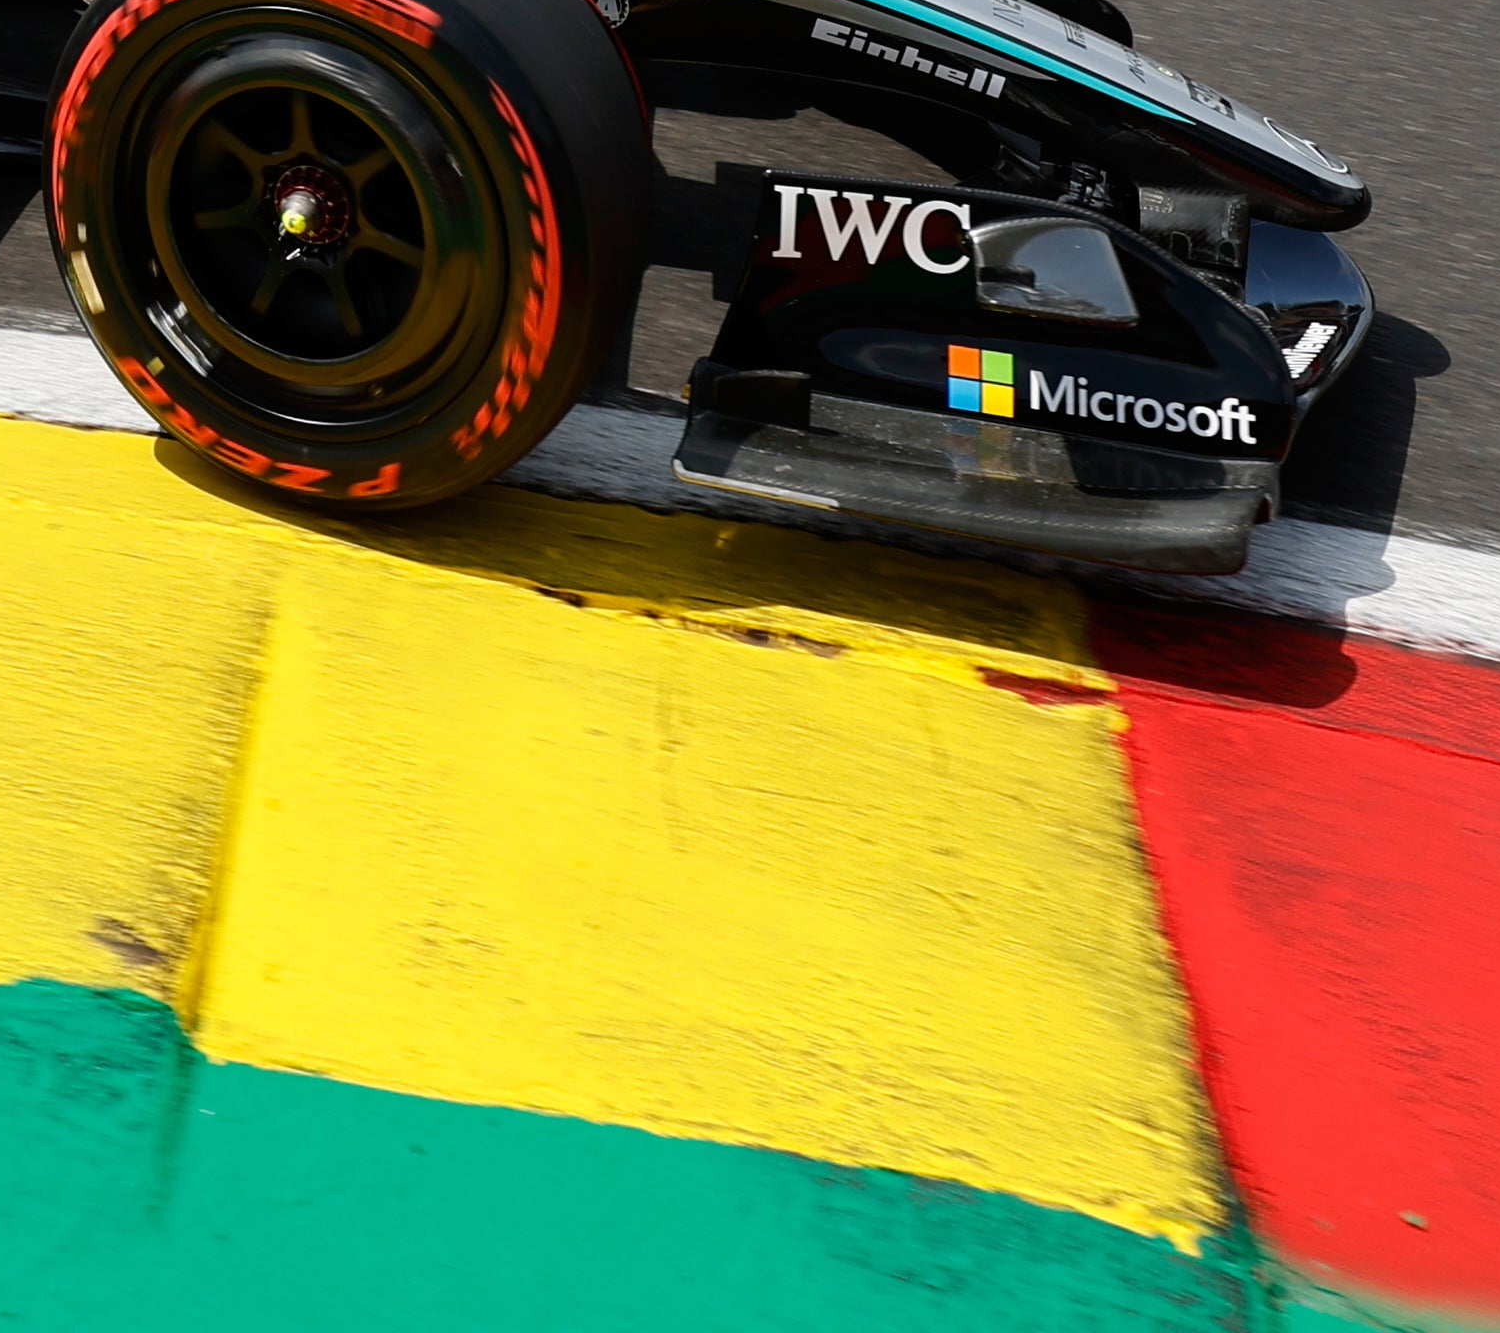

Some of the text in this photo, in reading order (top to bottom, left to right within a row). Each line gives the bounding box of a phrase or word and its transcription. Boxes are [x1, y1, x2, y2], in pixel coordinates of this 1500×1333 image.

[811, 17, 1006, 99] Einhell
[772, 184, 971, 274] IWC
[118, 355, 402, 499] P ZERO
[1029, 368, 1258, 445] Microsoft
